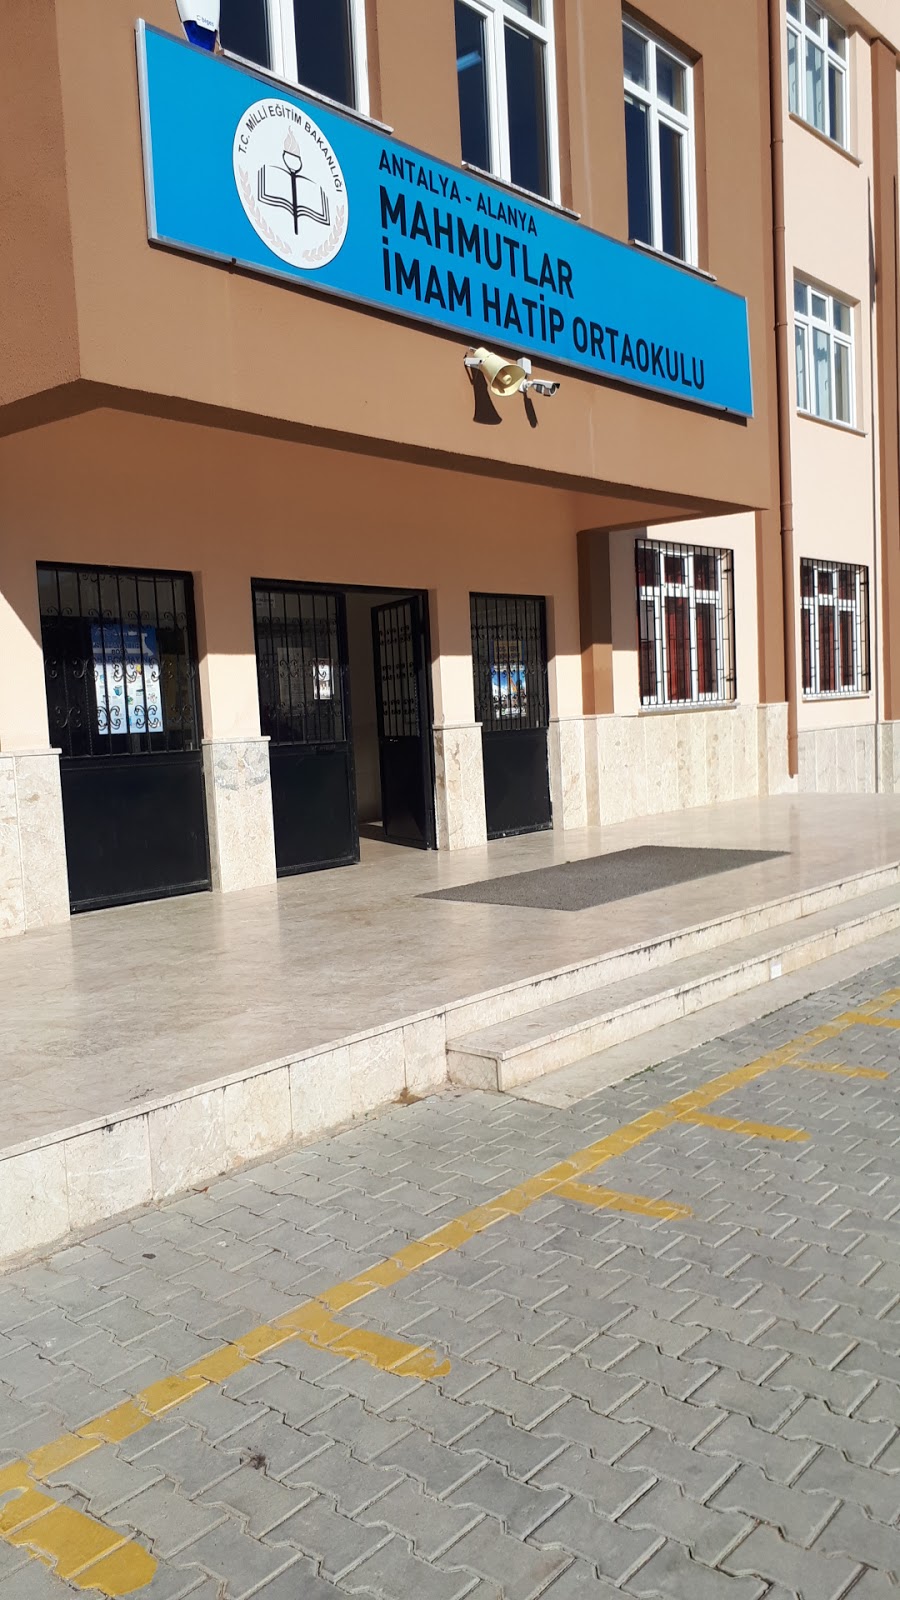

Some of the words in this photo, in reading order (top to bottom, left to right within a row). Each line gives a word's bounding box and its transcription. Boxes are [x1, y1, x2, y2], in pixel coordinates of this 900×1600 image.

[238, 134, 251, 154] T.C.
[246, 105, 268, 133] MİLLİ
[268, 103, 302, 126] EĞİTİM
[304, 121, 343, 193] BAKANLIĞI
[379, 149, 462, 204] ANTALYA
[476, 192, 538, 237] ALANYA
[379, 185, 575, 300] MAHMUTLAR
[382, 236, 472, 318] İMAM
[482, 282, 565, 345] HATİP
[572, 316, 705, 390] ORTAOKULU
